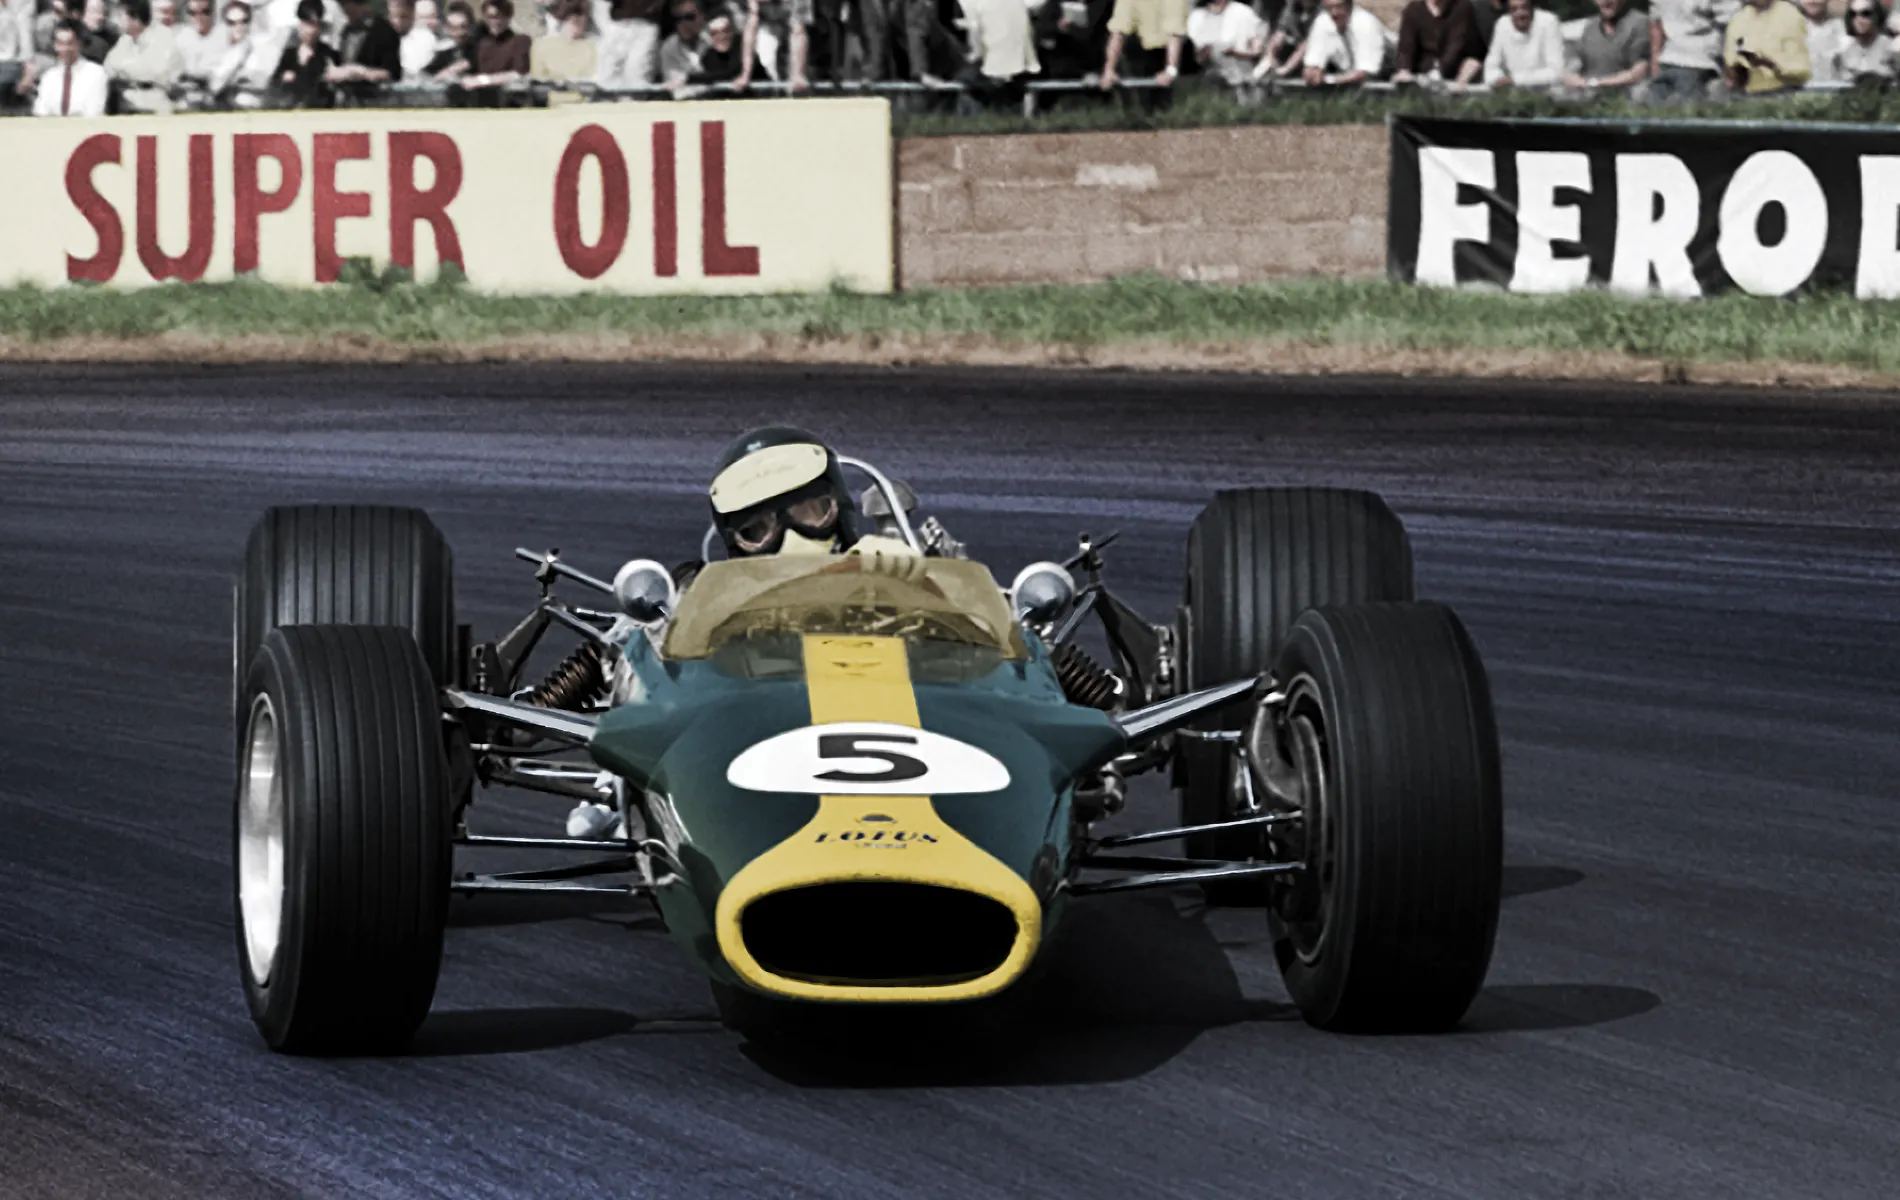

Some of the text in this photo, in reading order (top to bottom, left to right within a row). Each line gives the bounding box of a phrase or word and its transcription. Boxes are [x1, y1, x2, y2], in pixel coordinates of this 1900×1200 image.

[65, 120, 761, 283] SUPER OIL
[813, 732, 929, 783] 5
